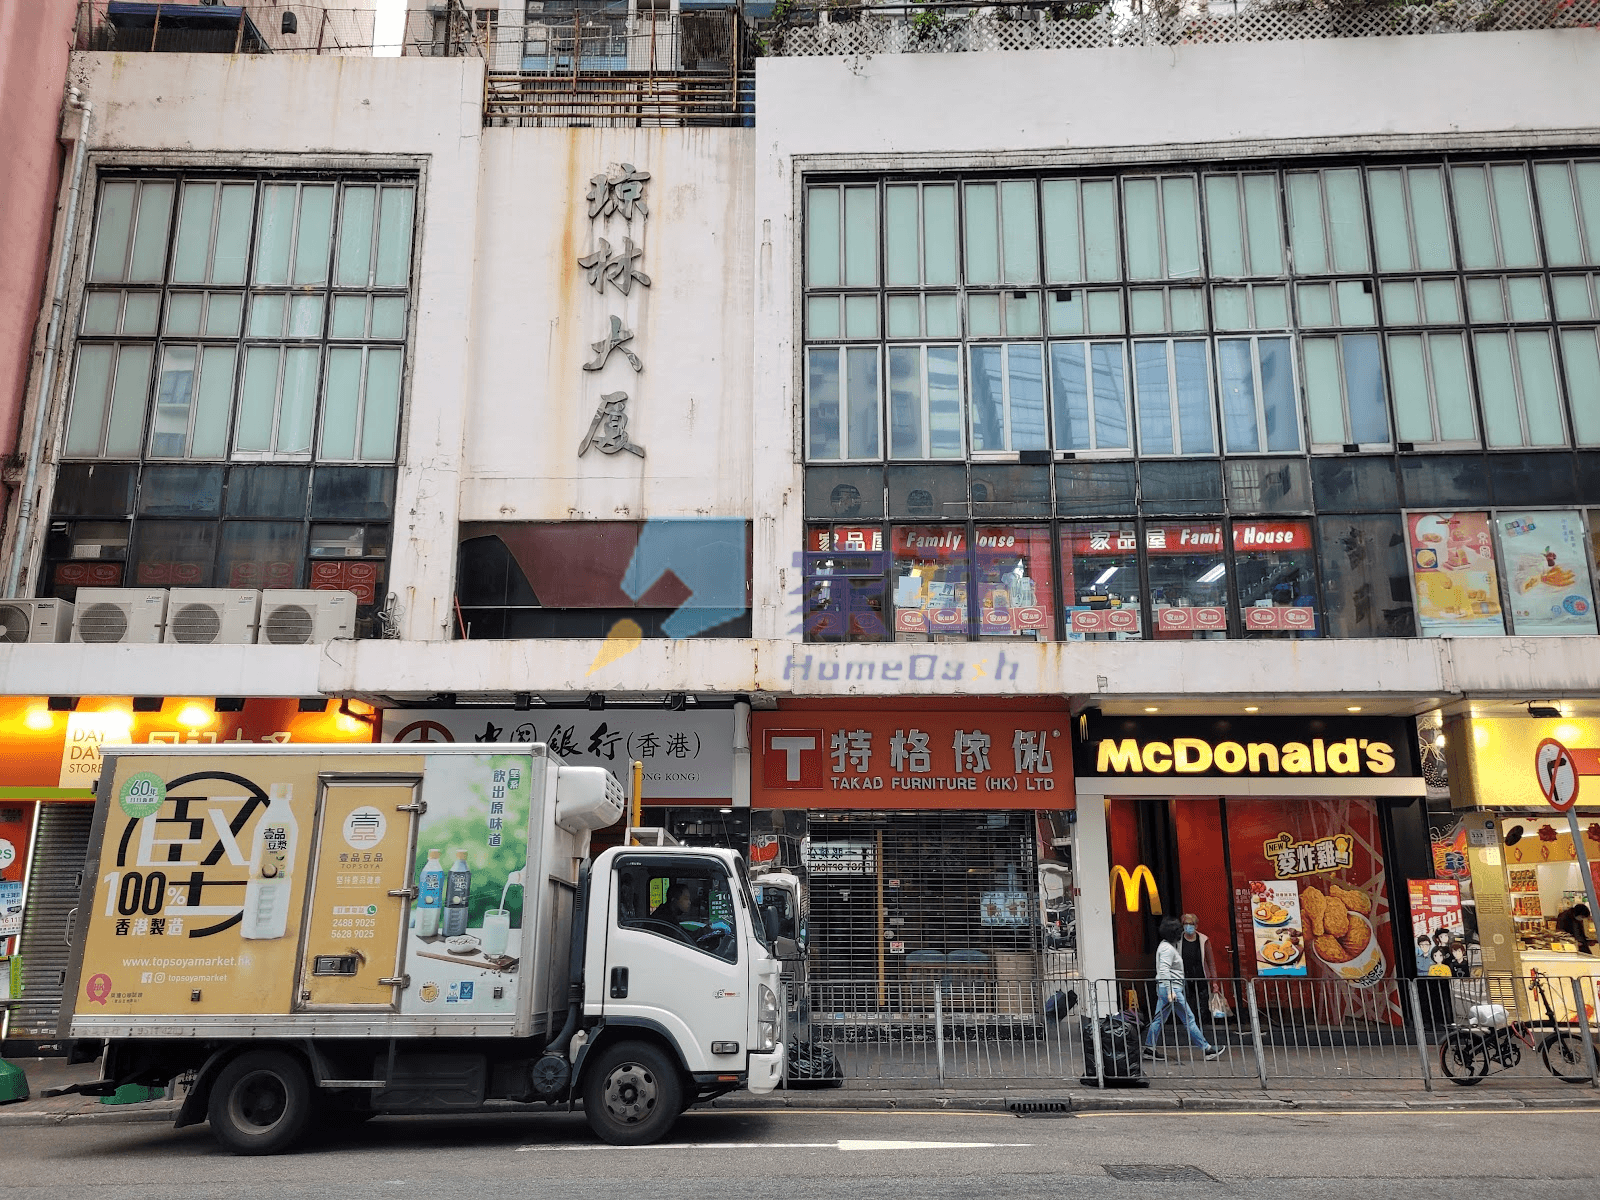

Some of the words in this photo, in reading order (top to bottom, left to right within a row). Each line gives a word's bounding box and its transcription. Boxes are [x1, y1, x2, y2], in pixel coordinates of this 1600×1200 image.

[906, 531, 962, 551] Family
[1180, 528, 1238, 545] Fami
[1243, 526, 1294, 545] House
[1096, 738, 1396, 773] McDonald's
[830, 777, 884, 790] TAKAD
[892, 777, 976, 790] FURNITURE
[985, 777, 1018, 791] (HK)
[1026, 777, 1054, 790] LTD
[488, 769, 506, 847] 飲出原味道
[1268, 842, 1284, 852] NEW
[104, 871, 186, 916] 100%
[115, 918, 184, 936] 香港製造
[333, 919, 353, 927] 2488
[355, 919, 376, 927] 9025
[331, 930, 352, 938] 5628
[354, 930, 375, 938] 9025
[123, 956, 251, 969] www.topsoyamarket.hk
[168, 974, 228, 983] topsoyamarket
